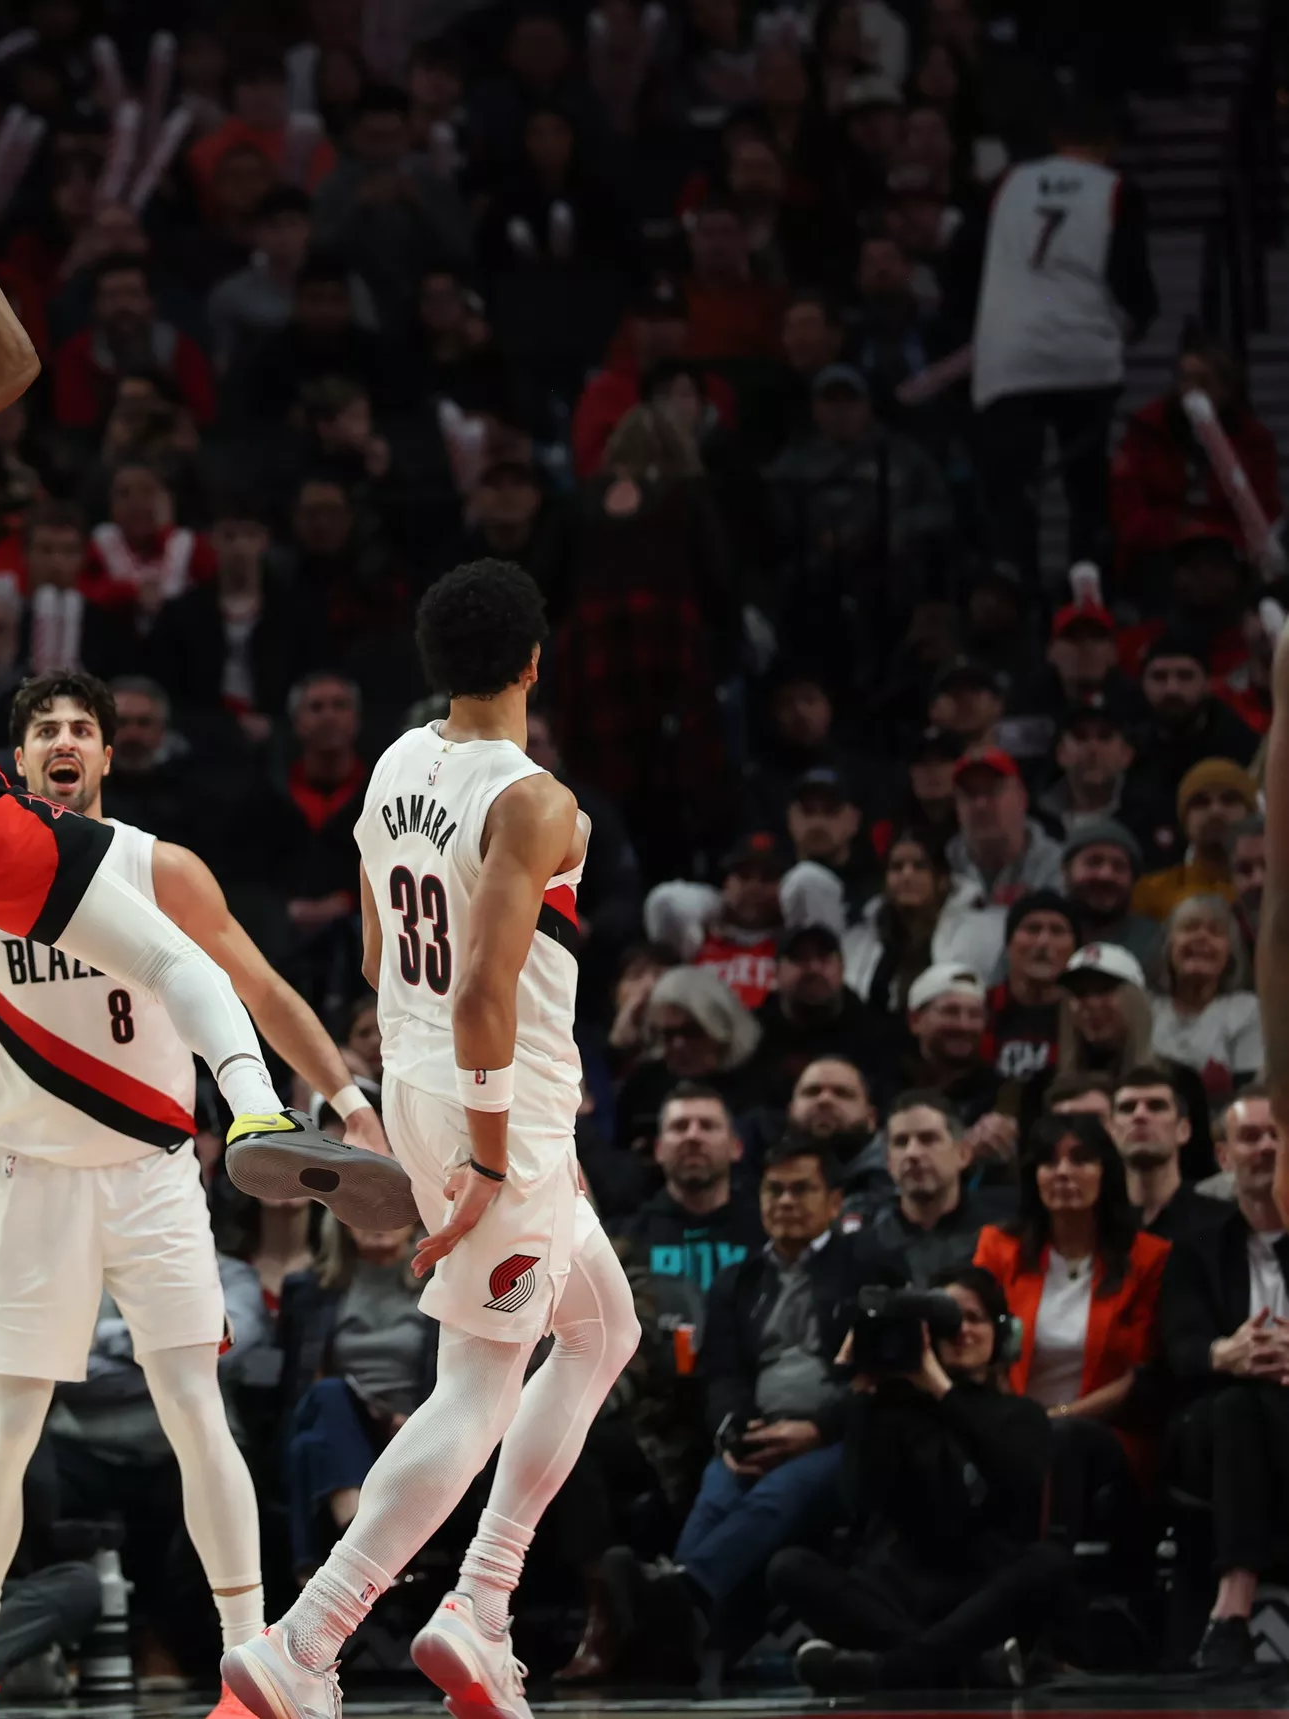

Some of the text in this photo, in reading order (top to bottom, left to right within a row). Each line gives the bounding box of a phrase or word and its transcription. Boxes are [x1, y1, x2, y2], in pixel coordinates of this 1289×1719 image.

[382, 794, 457, 856] CAMARA
[389, 865, 452, 995] 33
[107, 988, 135, 1044] 8
